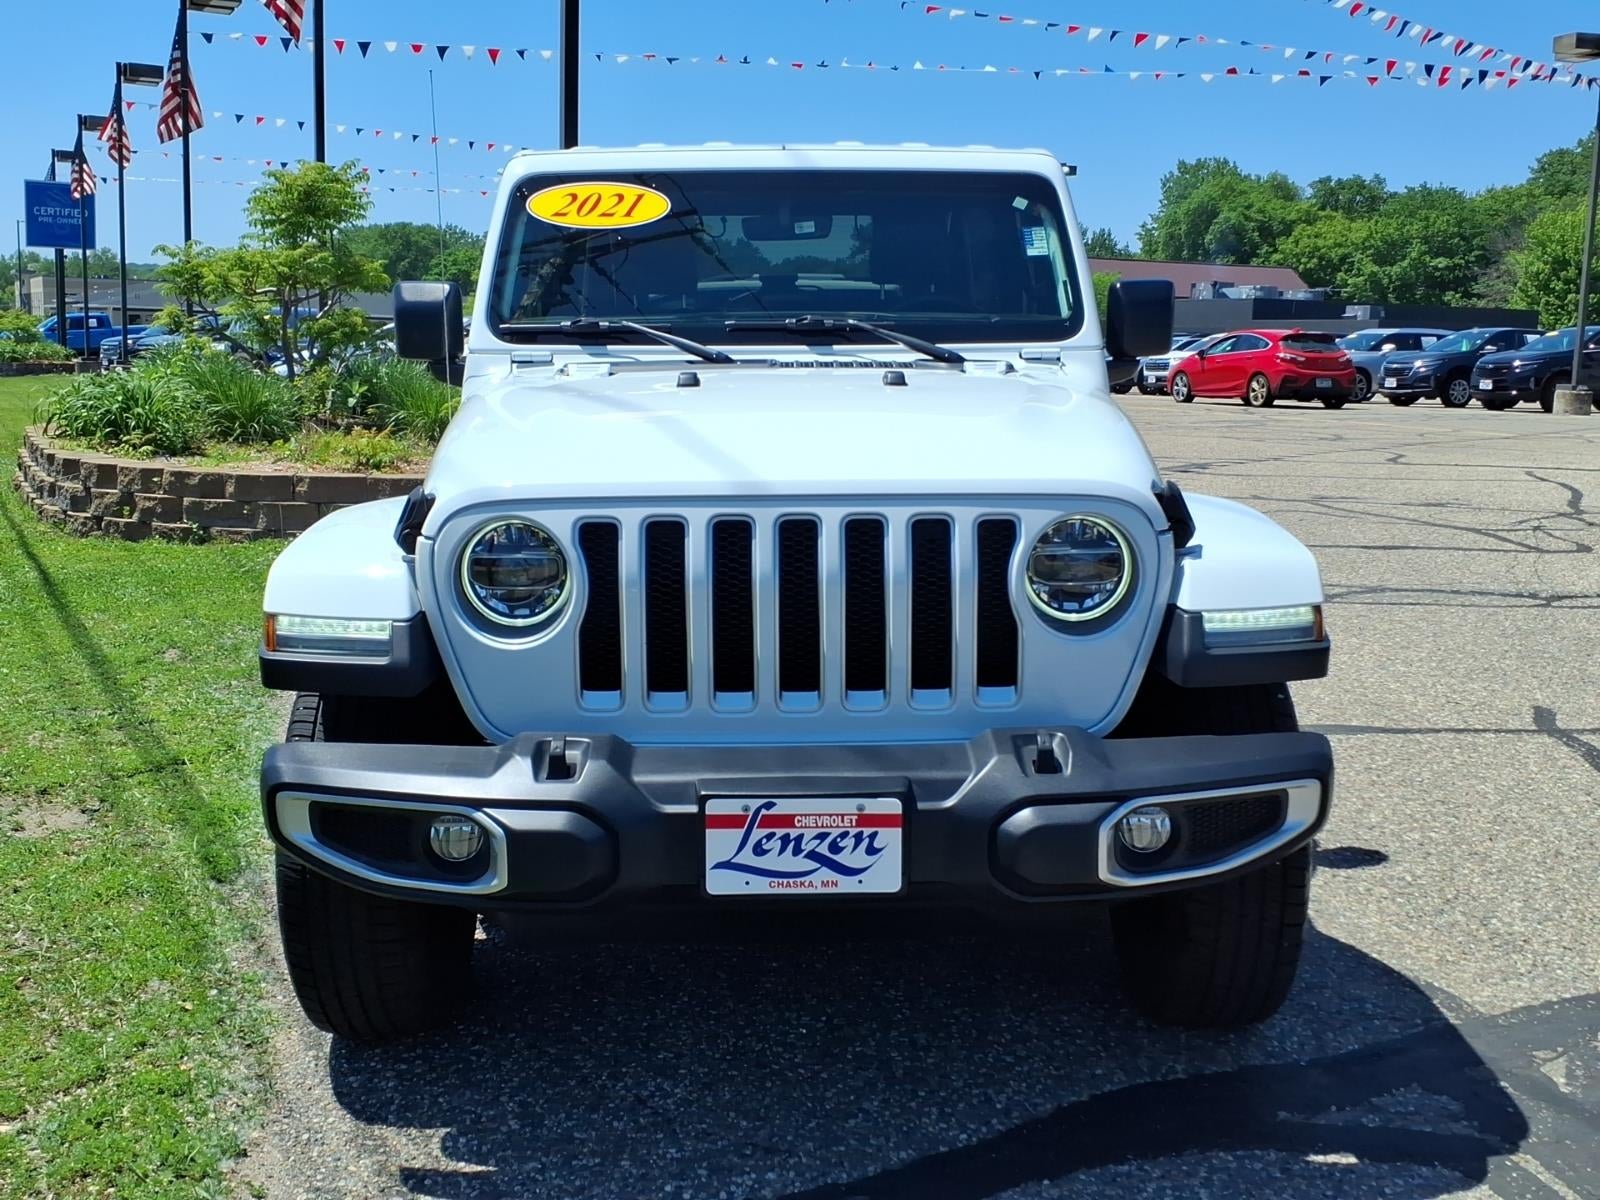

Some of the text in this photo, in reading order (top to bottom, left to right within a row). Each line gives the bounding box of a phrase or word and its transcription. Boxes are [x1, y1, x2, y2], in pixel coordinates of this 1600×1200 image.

[551, 192, 645, 218] 2021
[794, 815, 858, 827] CHEVROLET
[709, 800, 888, 879] Lenzen
[768, 880, 838, 890] CHASKA, MN
